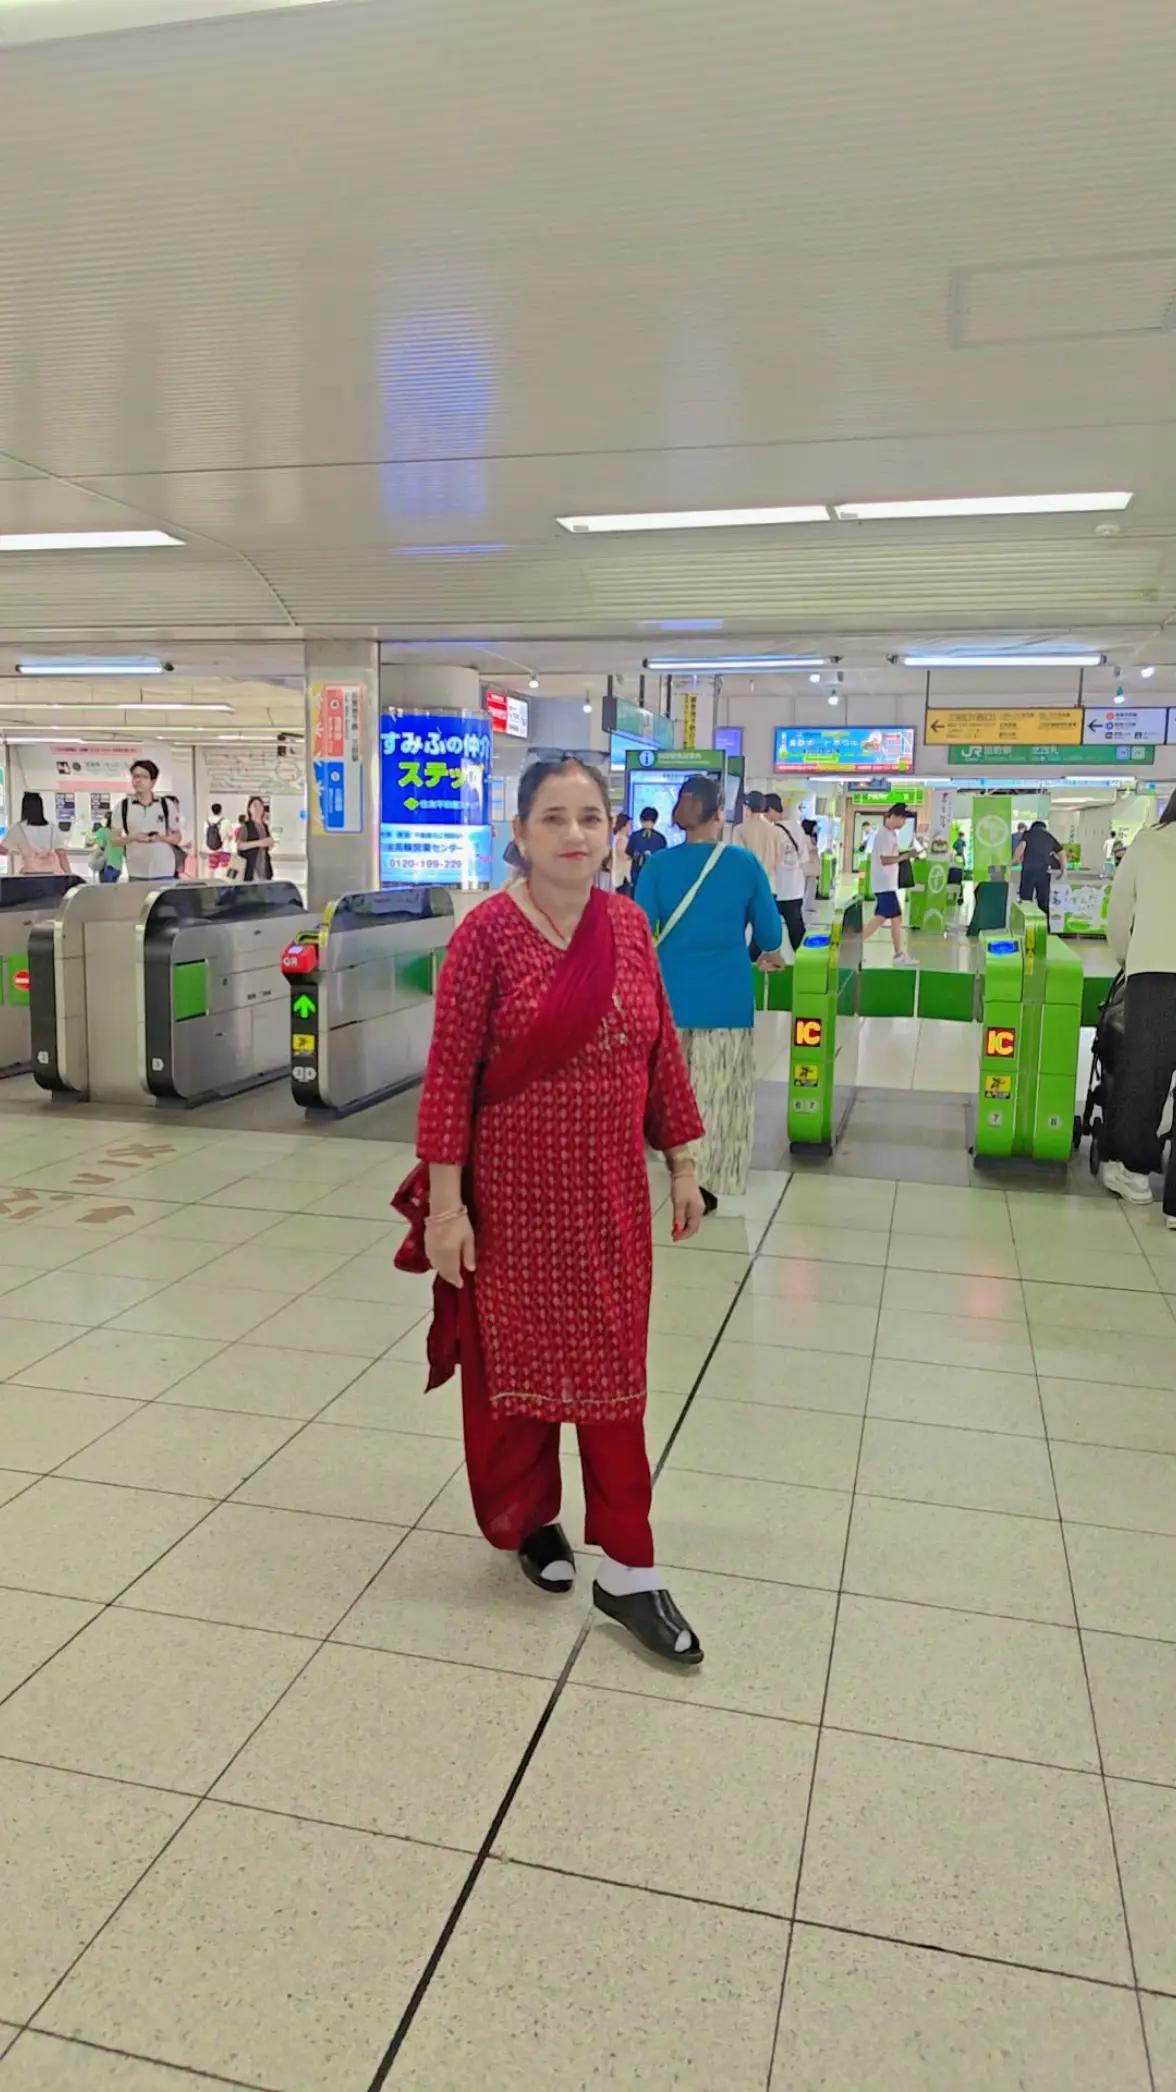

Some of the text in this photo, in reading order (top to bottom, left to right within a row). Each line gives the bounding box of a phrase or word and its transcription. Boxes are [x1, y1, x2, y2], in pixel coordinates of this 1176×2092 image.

[380, 730, 490, 759] すみふの仲介
[961, 745, 983, 758] JR
[398, 762, 484, 789] ステッ
[797, 1021, 820, 1045] IC
[988, 1031, 1014, 1055] IC
